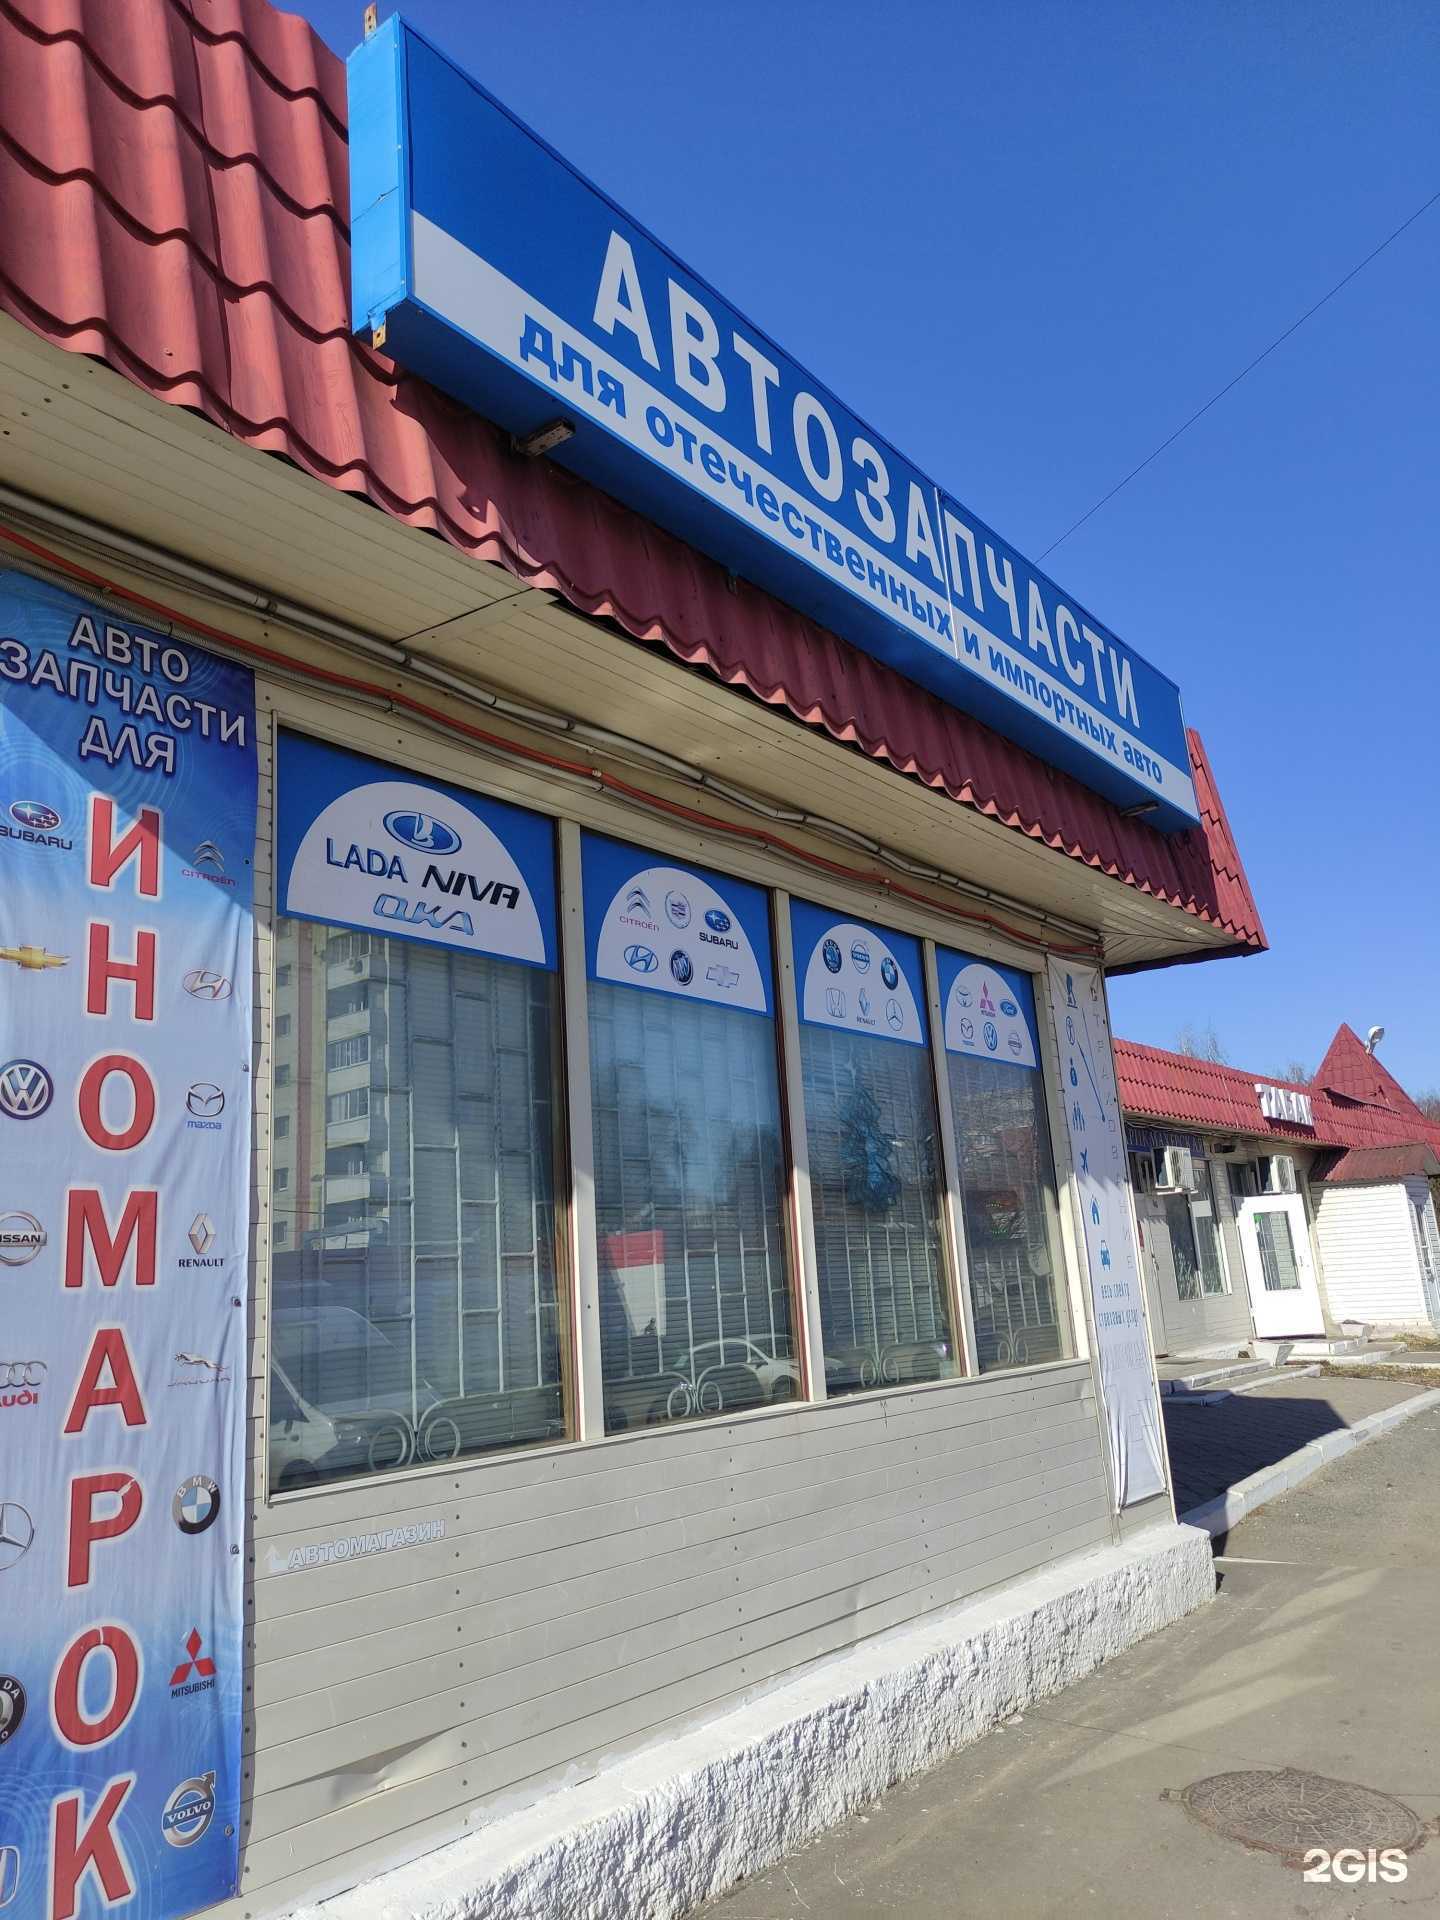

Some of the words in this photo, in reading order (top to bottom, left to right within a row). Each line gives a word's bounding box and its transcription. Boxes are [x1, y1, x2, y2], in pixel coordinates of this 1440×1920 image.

[592, 230, 1140, 728] АВТОЗАПЧАСТИ
[519, 313, 627, 419] для
[645, 406, 954, 642] отечественных
[963, 627, 981, 661] и
[988, 645, 1119, 755] импортных
[1123, 739, 1163, 784] авто
[70, 615, 190, 683] АВТО
[0, 640, 246, 747] ЗАПЧАСТИ
[80, 717, 175, 774] ДЛЯ
[0, 825, 73, 850] SUBARU
[326, 837, 408, 883] LADA
[421, 864, 521, 910] NIVA
[699, 932, 739, 950] SUBARU
[0, 1234, 41, 1243] ISSAN
[178, 1257, 225, 1268] RENAULT
[53, 796, 161, 1920] ИНОМАРОК
[177, 1476, 220, 1498] BMW
[287, 1519, 446, 1570] АВТОМАГАЗИН
[171, 1678, 216, 1698] MITSUBISHI
[167, 1800, 212, 1824] VOLVO
